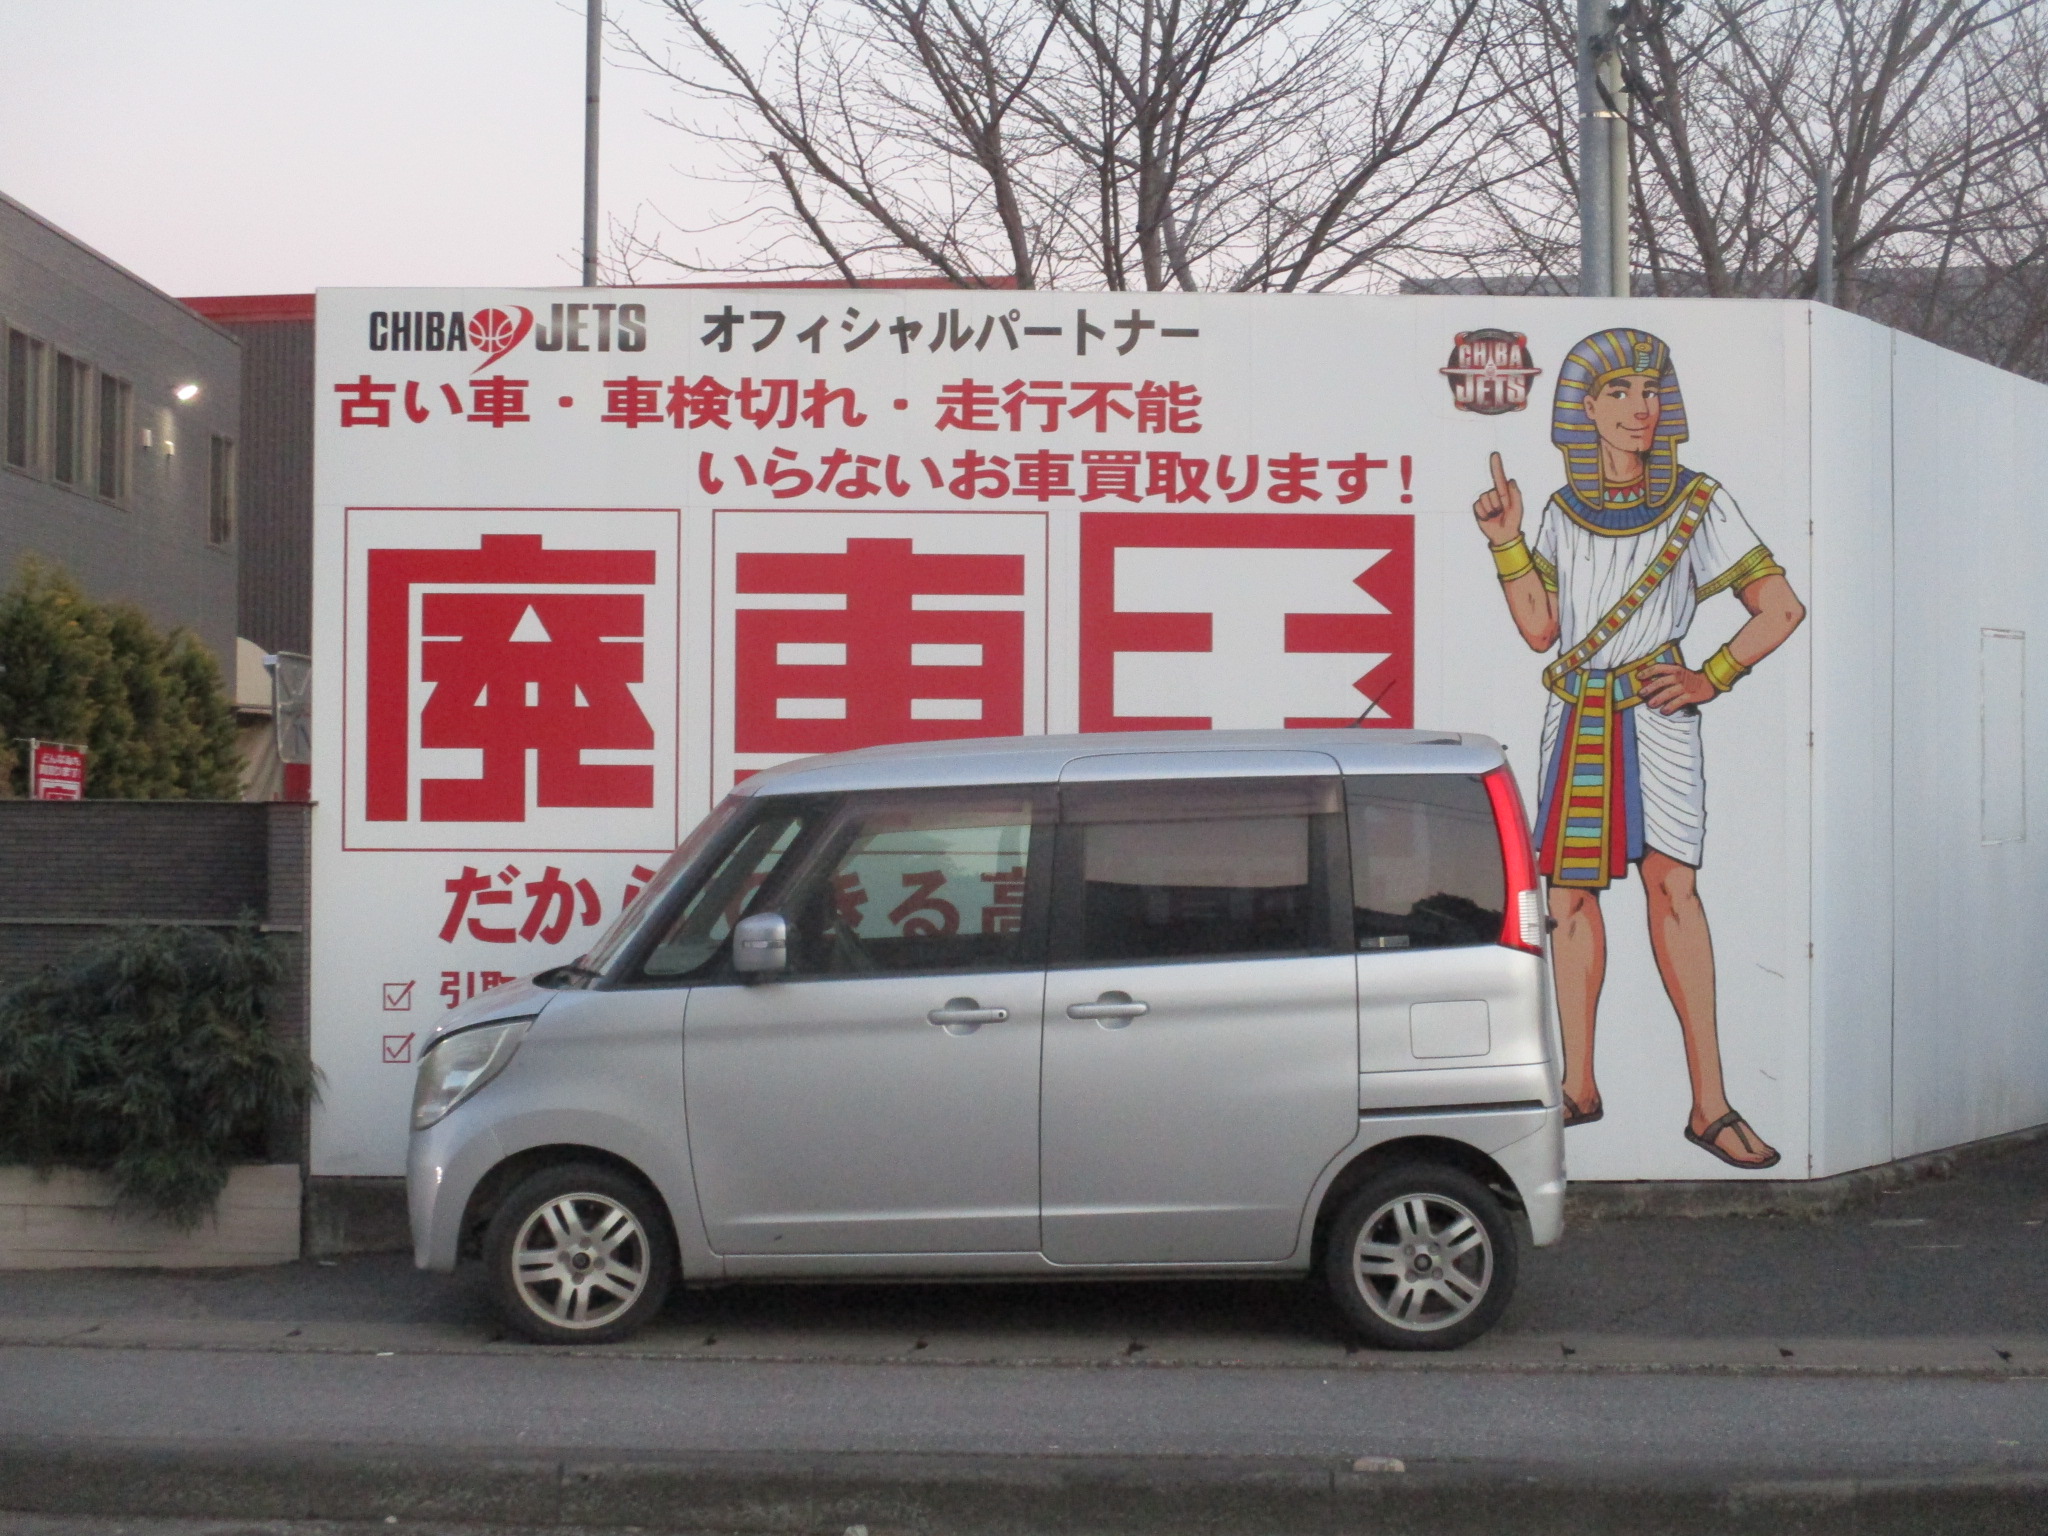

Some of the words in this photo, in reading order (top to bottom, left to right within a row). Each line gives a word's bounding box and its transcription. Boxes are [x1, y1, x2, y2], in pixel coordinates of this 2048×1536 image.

[368, 310, 467, 352] CHIBA
[534, 303, 647, 353] JETS
[700, 305, 1200, 356] オフィシャルパートナー
[1455, 373, 1527, 406] JETS
[698, 445, 1414, 504] いらないお車買取ります!
